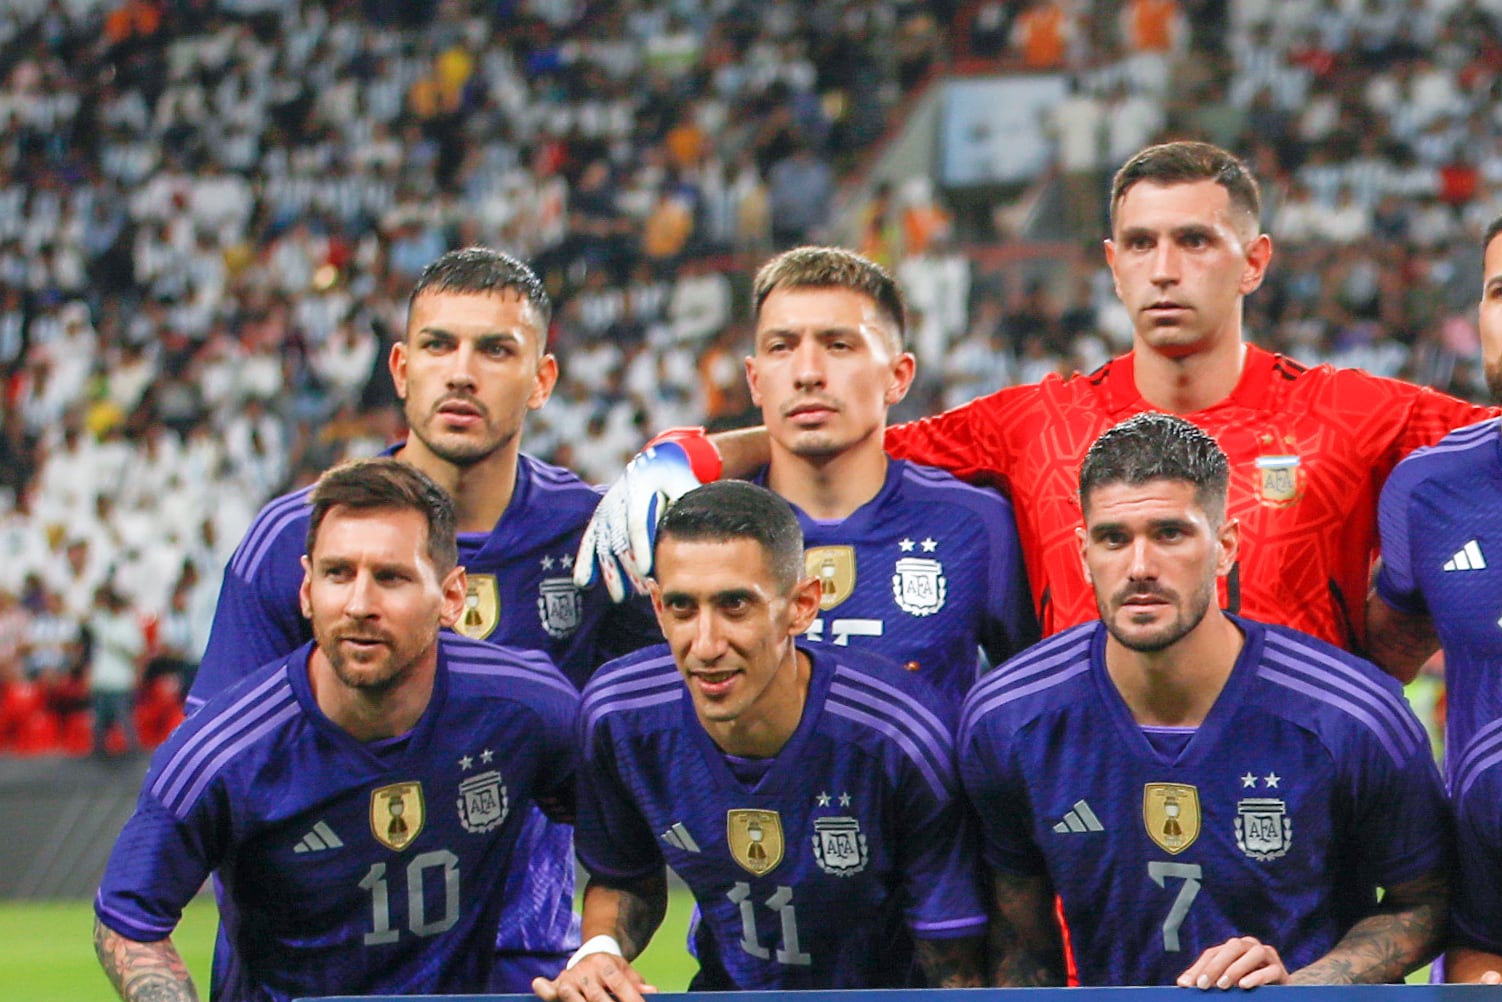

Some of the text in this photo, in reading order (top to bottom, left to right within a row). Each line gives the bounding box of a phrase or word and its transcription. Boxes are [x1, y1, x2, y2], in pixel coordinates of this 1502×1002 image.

[906, 575, 933, 599] AFA
[470, 789, 497, 815] AFA
[1248, 815, 1278, 843] AFA
[826, 833, 854, 859] AFA
[358, 850, 460, 947] 10
[1147, 861, 1203, 952] 7
[726, 881, 812, 966] 11
